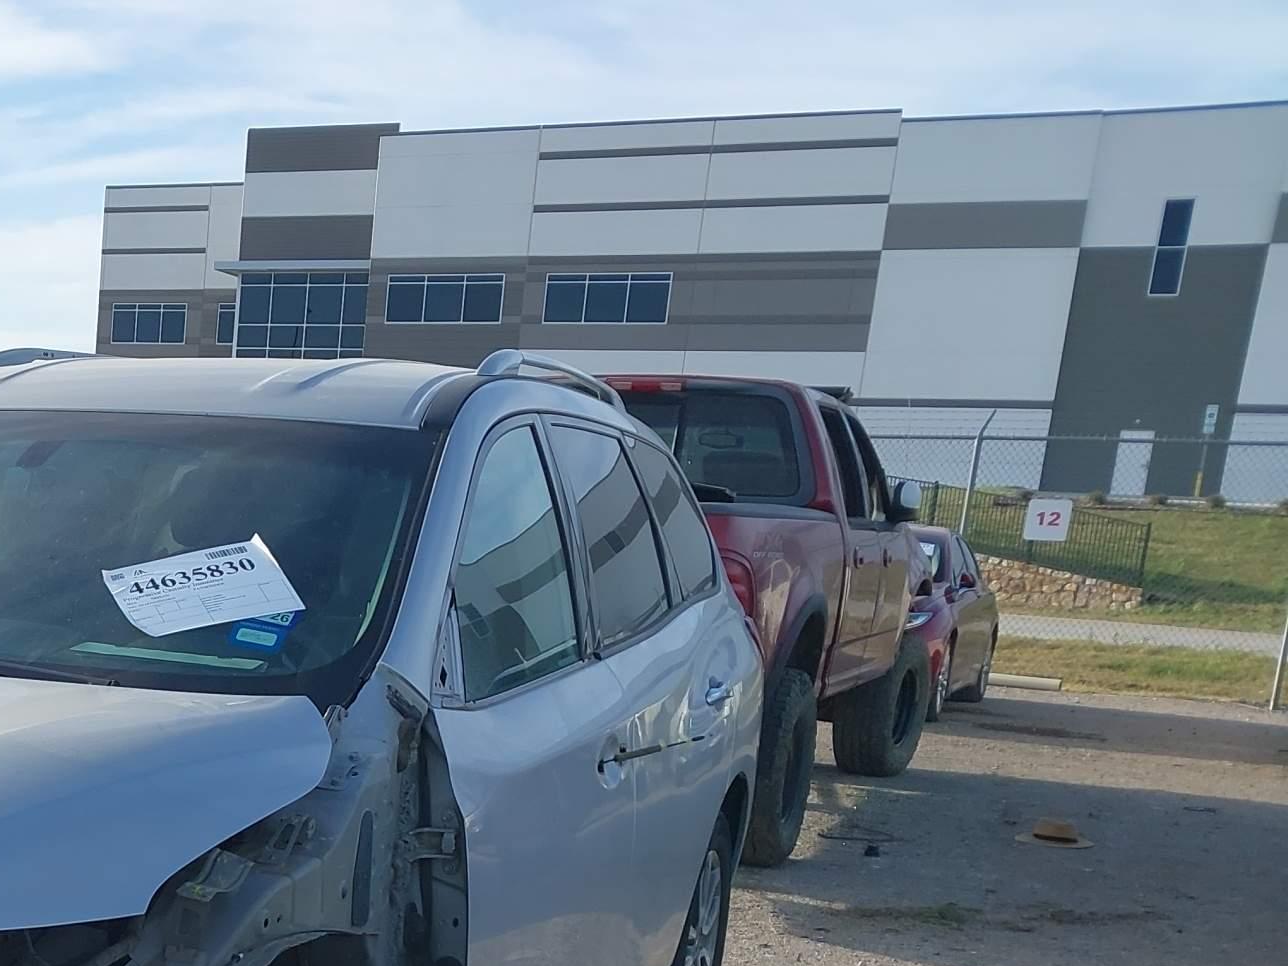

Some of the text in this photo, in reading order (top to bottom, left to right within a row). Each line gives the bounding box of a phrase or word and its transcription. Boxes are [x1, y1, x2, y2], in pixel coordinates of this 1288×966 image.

[1036, 511, 1061, 526] 12
[129, 557, 256, 595] 44635830
[270, 612, 290, 623] 26
